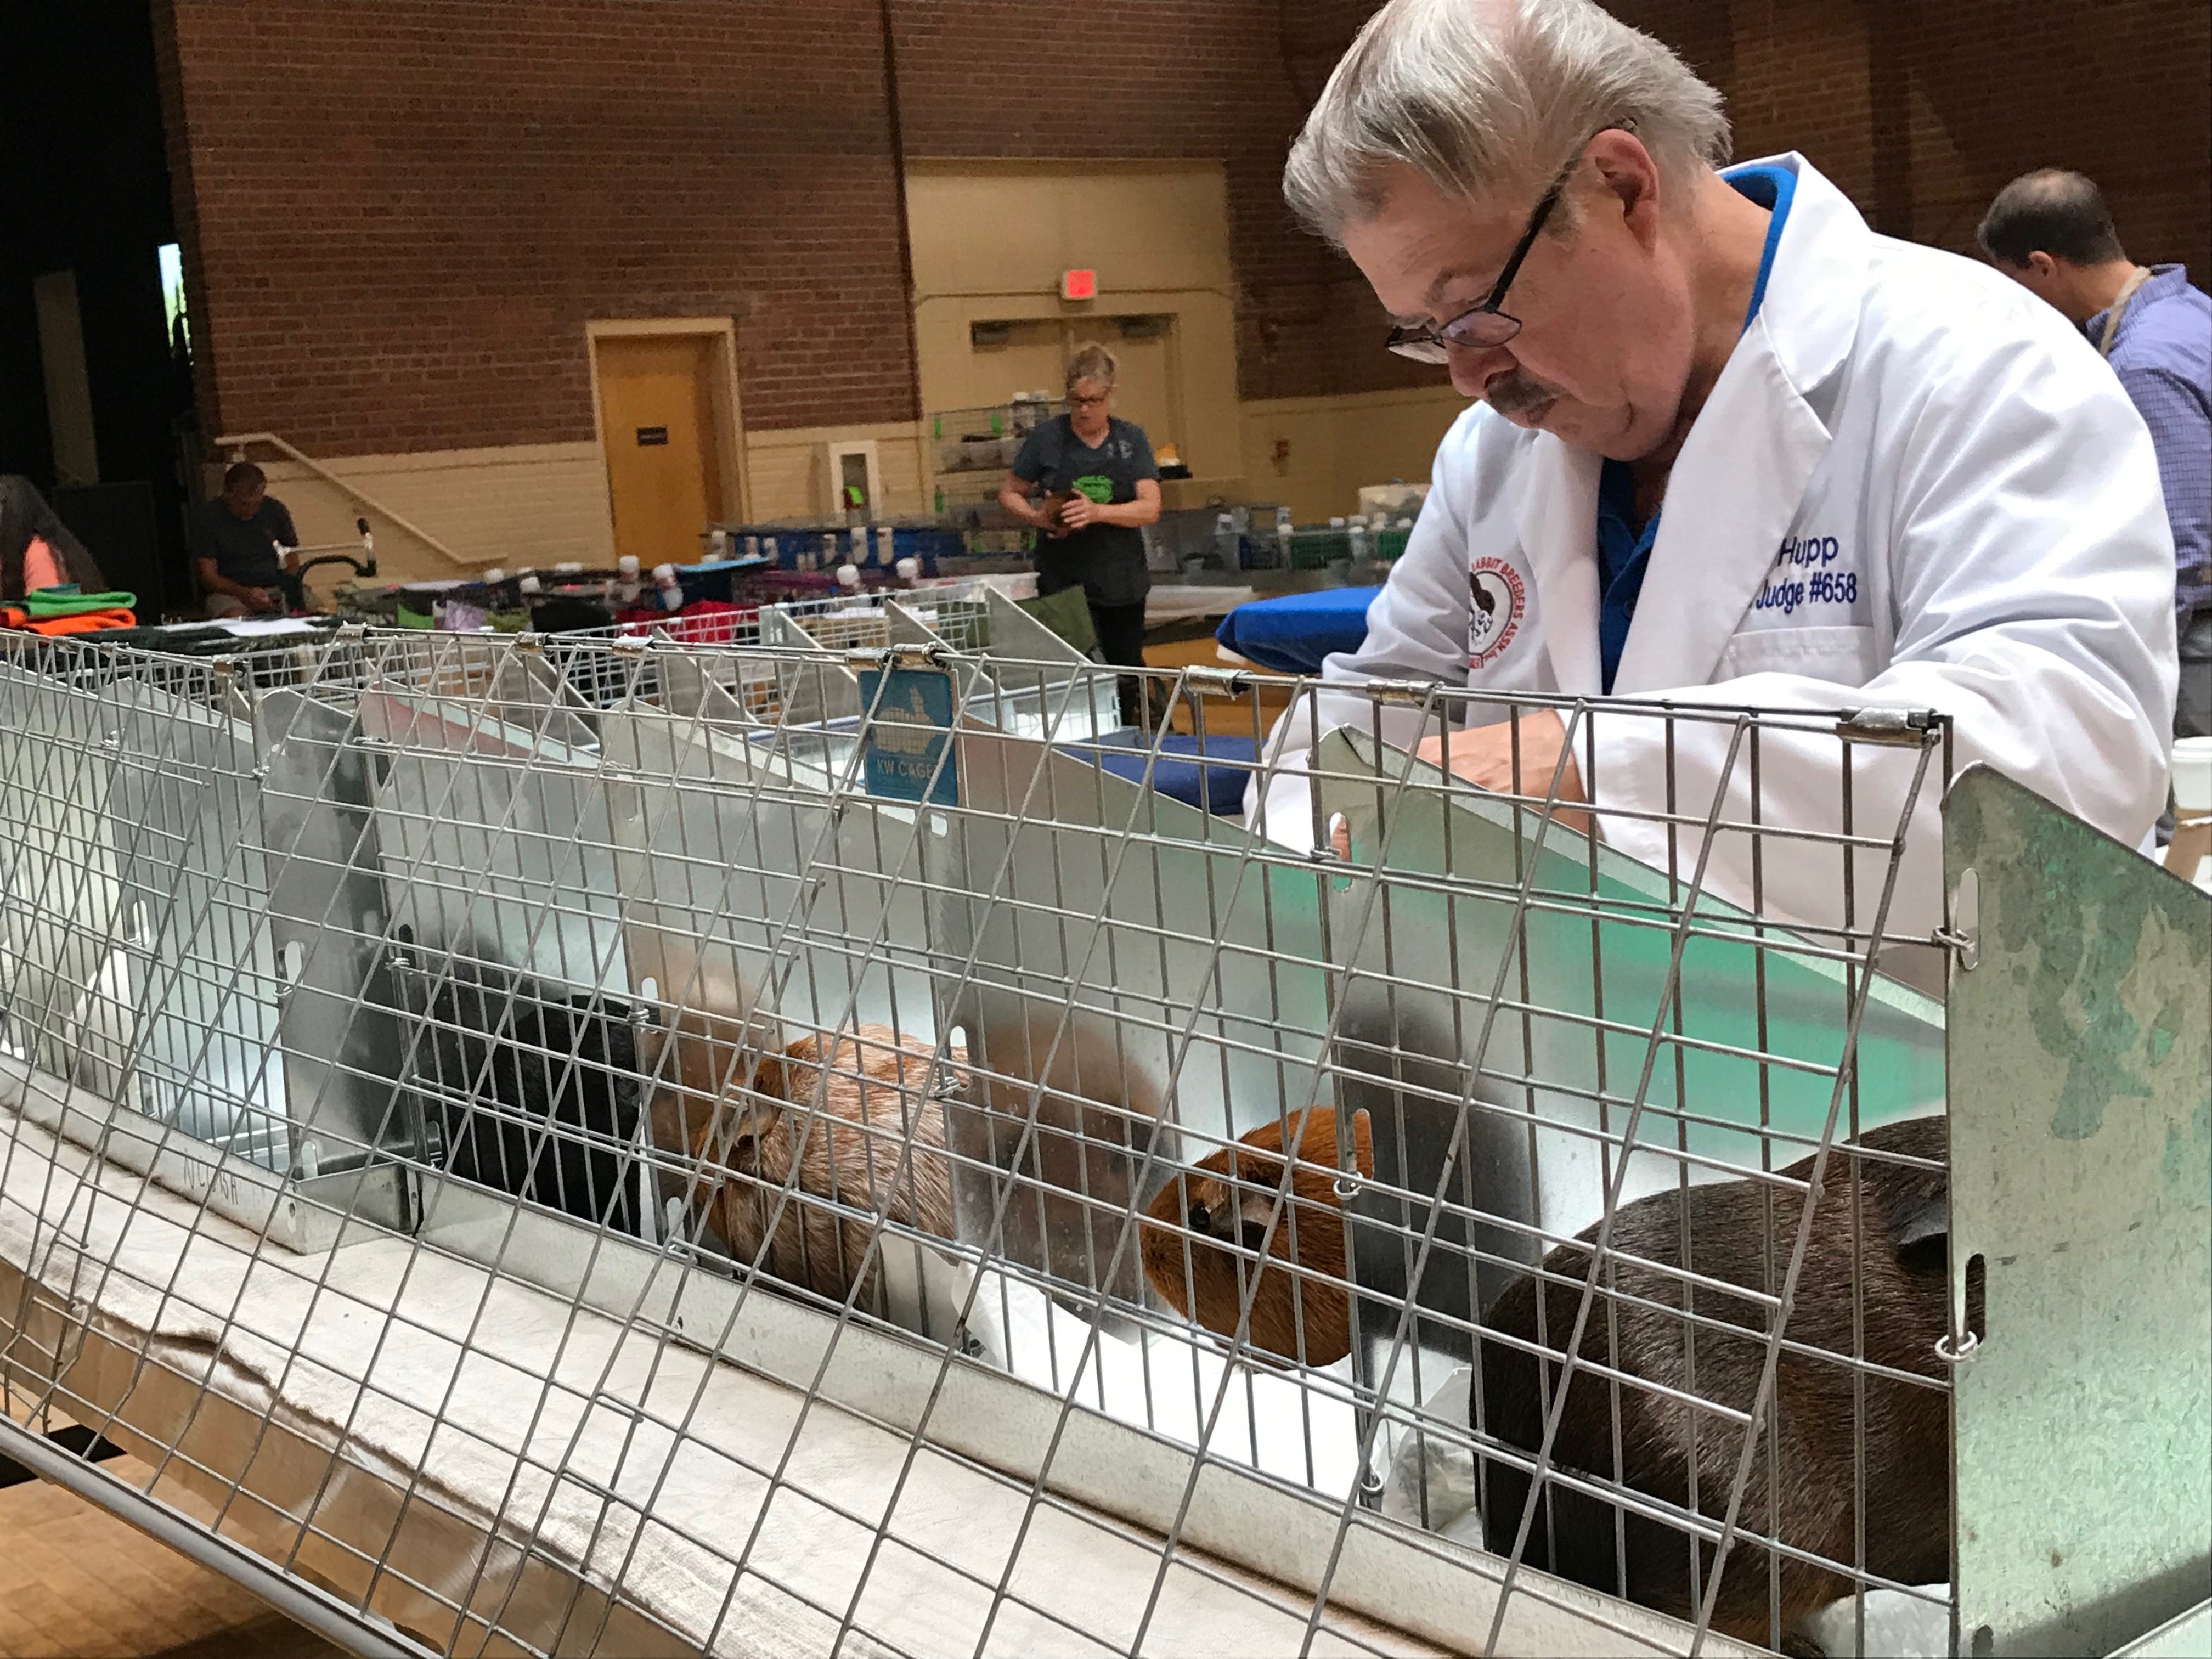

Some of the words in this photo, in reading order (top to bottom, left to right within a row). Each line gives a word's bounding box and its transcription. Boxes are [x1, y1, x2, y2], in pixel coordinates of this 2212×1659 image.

[1778, 536, 1838, 568] Hupp
[1756, 578, 1804, 614] Judge
[1809, 571, 1857, 603] #658
[877, 758, 894, 776] KW
[898, 760, 938, 779] CAGE
